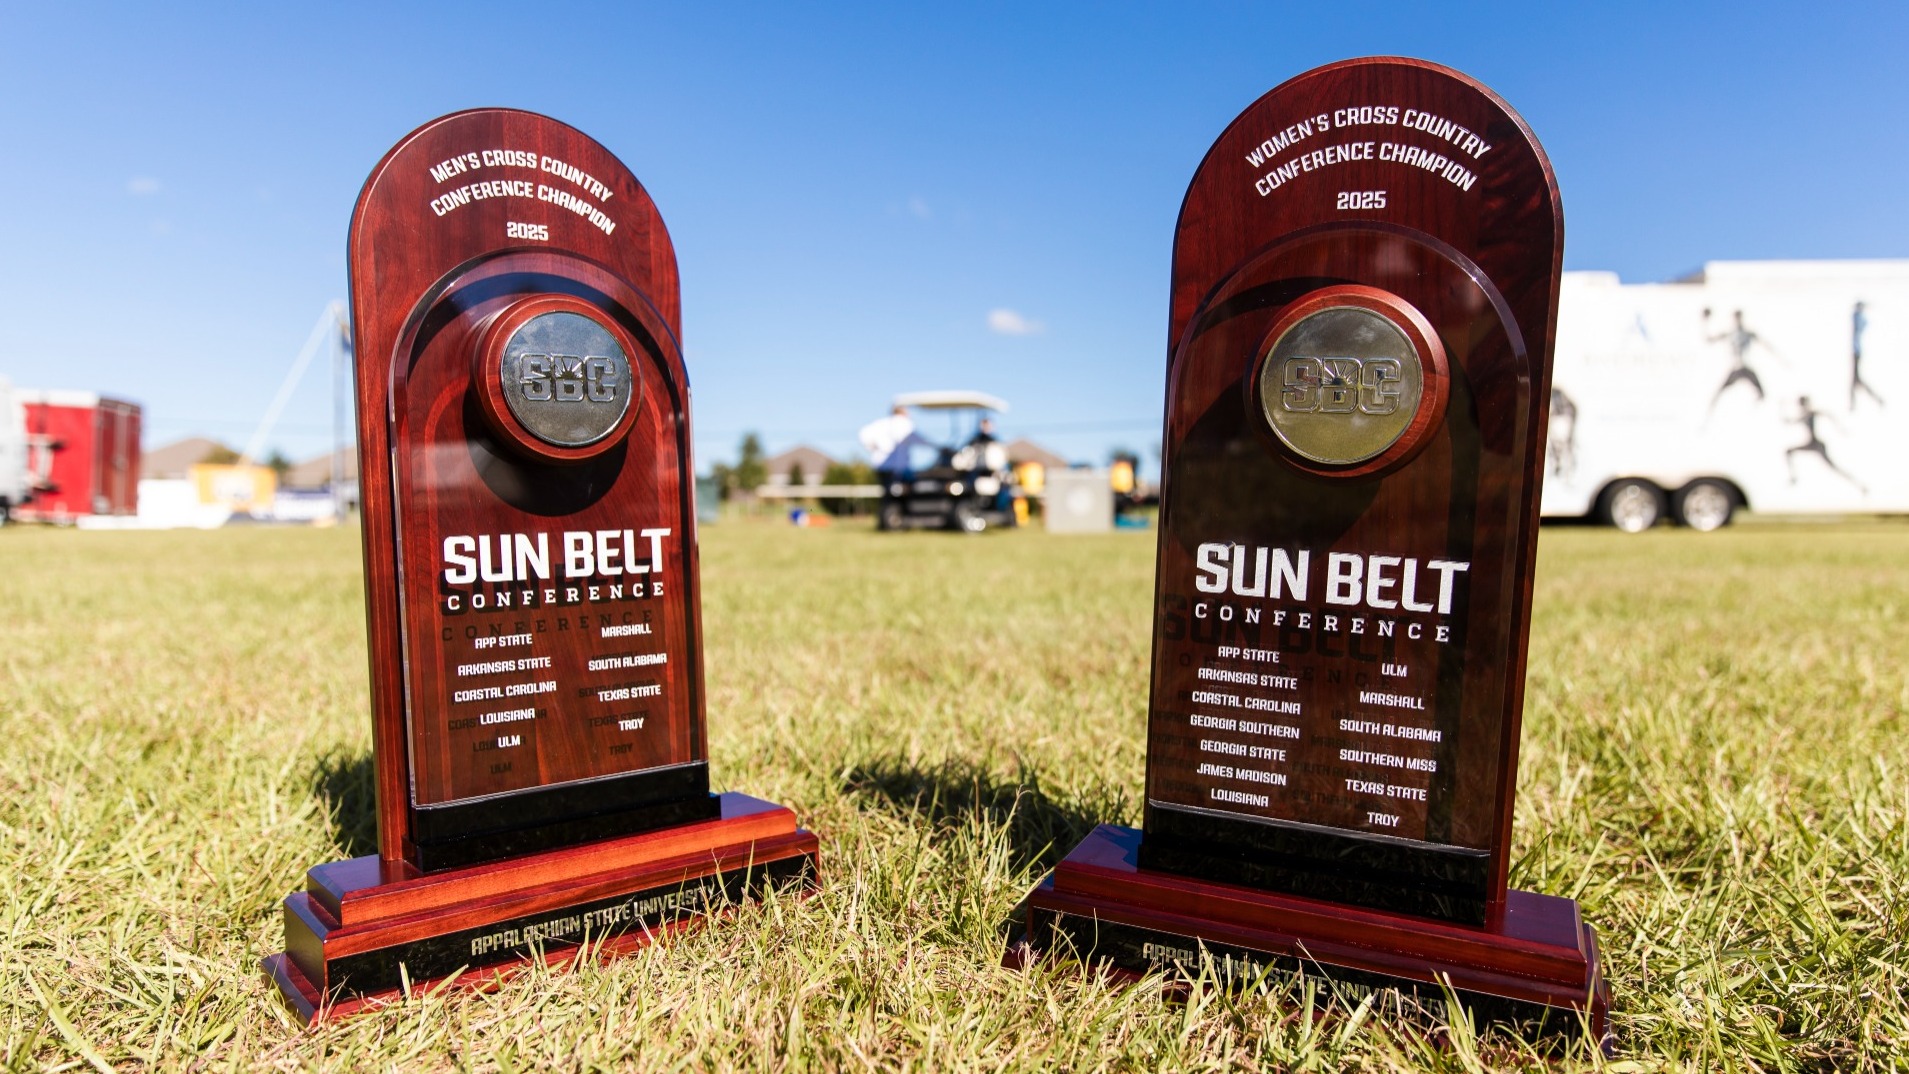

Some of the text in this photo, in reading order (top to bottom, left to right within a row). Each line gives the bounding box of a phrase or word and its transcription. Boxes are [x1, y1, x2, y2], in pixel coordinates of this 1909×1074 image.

[1245, 106, 1492, 168] WOMEN'S CROSS COUNTRY
[430, 149, 613, 203] MEN'S CROSS COUNTRY
[1255, 142, 1477, 197] CONFERENCE CHAMPION
[430, 180, 616, 236] CONFERENCE CHAMPION
[1336, 190, 1387, 210] 2025
[506, 221, 549, 242] 2025
[520, 354, 616, 402] SBC
[1282, 357, 1401, 415] SBC
[443, 527, 672, 585] SUN BELT
[1195, 541, 1470, 615] SUN BELT
[447, 582, 664, 611] CONFERENCE
[601, 623, 653, 639] MARSHALL
[1195, 603, 1450, 643] CONFERENCE
[474, 633, 533, 650] APP STATE
[588, 652, 668, 672] SOUTH ALABAMA
[1217, 645, 1280, 664] APP STATE
[457, 657, 551, 677] ARKANSAS STATE
[1197, 667, 1298, 690] ARKANSAS STATE
[1381, 662, 1408, 678] ULM
[454, 680, 557, 703] COASTAL CAROLINA
[597, 684, 662, 703] TEXAS STATE
[1191, 690, 1301, 715] COASTAL CAROLINA
[1359, 690, 1425, 710] MARSHALL
[479, 707, 536, 725] LOUISIANA
[617, 717, 645, 731] TROY
[1190, 714, 1300, 740] GEORGIA SOUTHERN
[497, 734, 521, 748] ULM
[1339, 718, 1442, 743] SOUTH ALABAMA
[1200, 739, 1287, 762] GEORGIA STATE
[1339, 748, 1437, 773] SOUTHERN MISS
[1196, 762, 1287, 786] JAMES MADISON
[1210, 787, 1269, 808] LOUISIANA
[1344, 778, 1427, 802] TEXAS STATE
[1366, 811, 1400, 827] TROY
[471, 914, 581, 956] APPALACHIAN
[583, 903, 631, 929] STATE
[1142, 942, 1264, 981] APPALCHIAN
